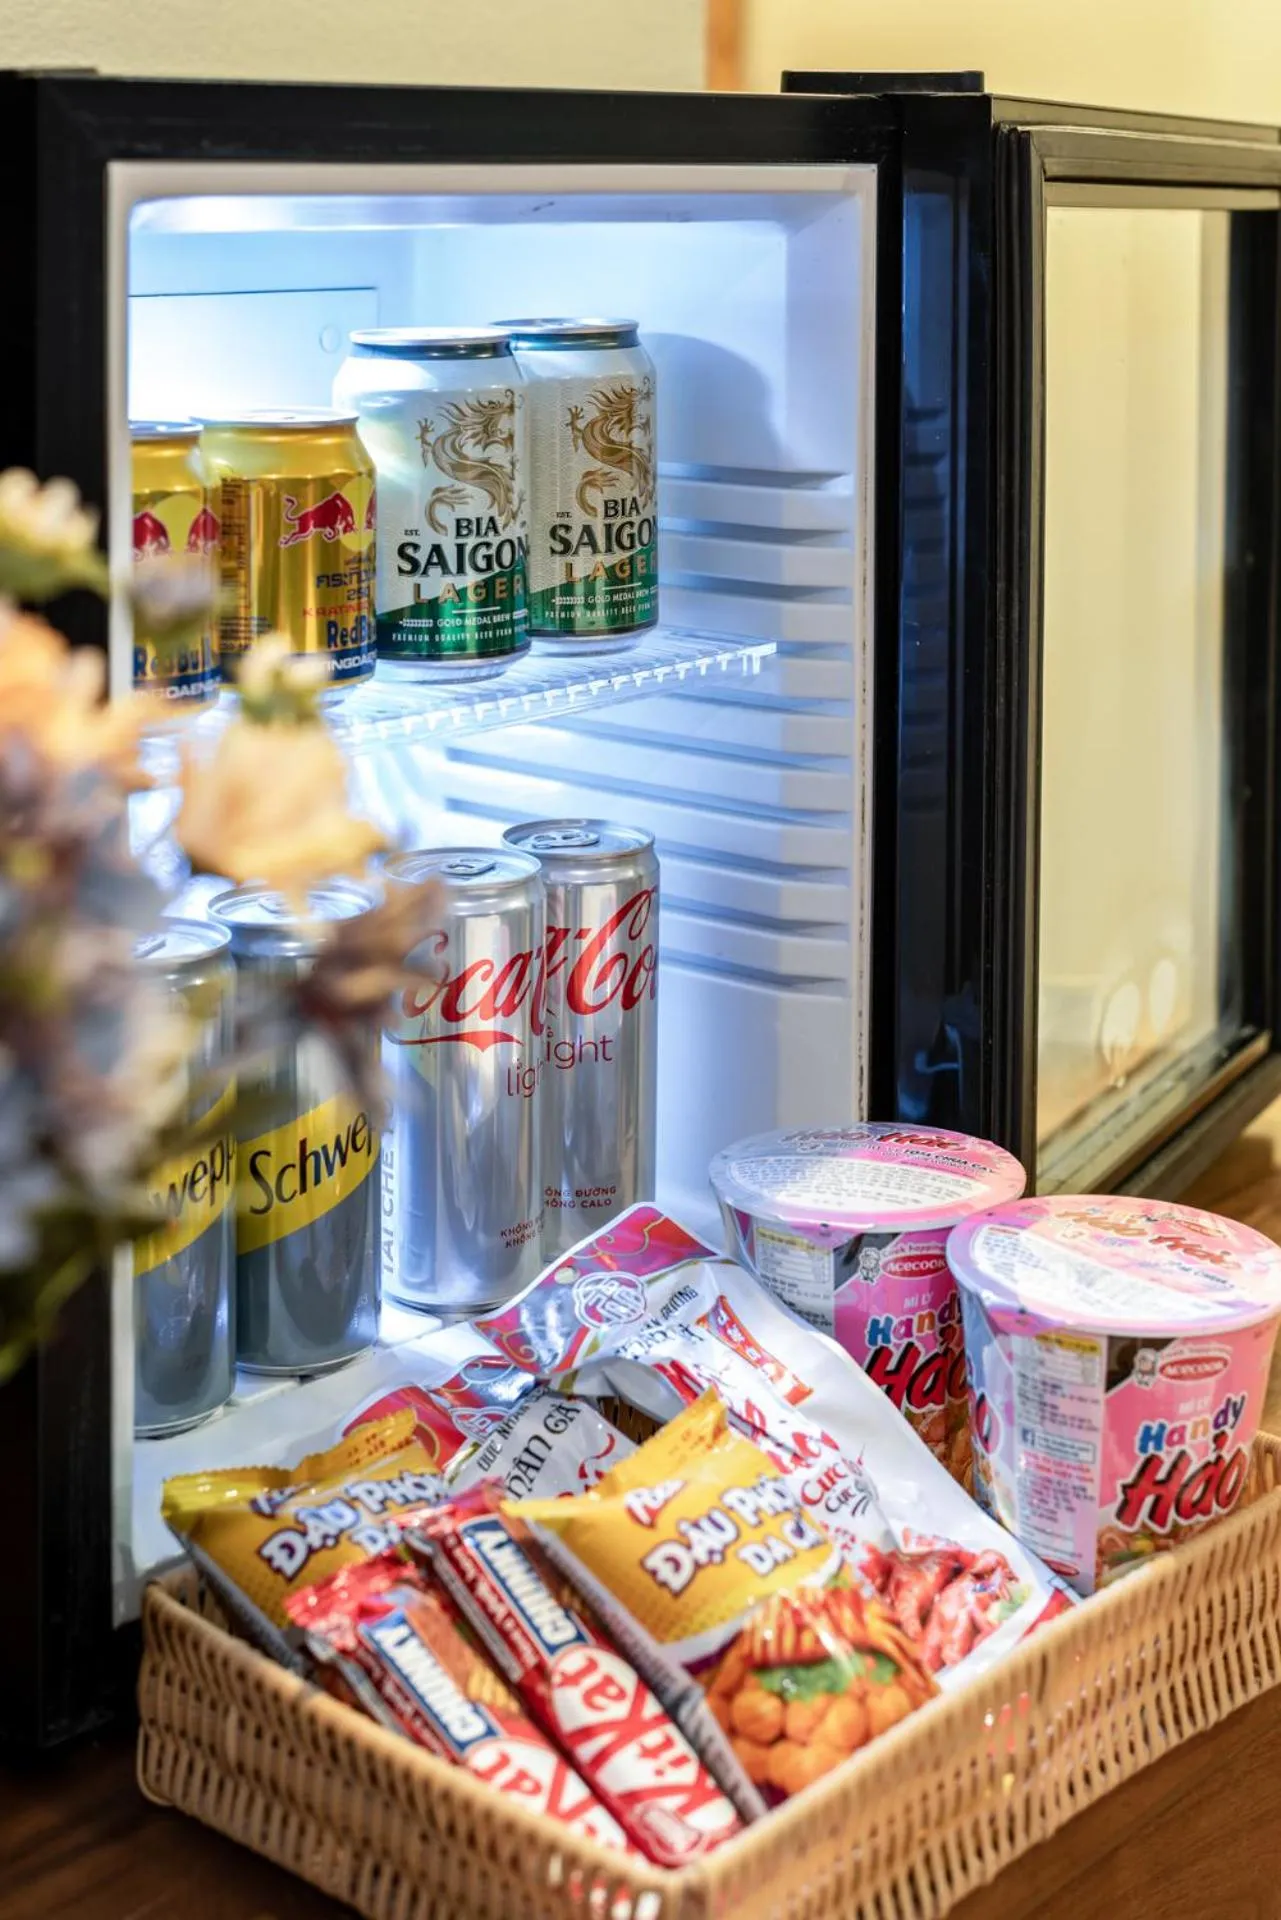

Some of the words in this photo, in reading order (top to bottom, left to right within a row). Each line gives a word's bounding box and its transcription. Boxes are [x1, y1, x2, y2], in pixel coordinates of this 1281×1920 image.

[556, 511, 572, 519] EST.
[603, 497, 641, 518] BIA
[403, 528, 420, 537] EST.
[455, 515, 500, 540] BIA
[397, 533, 529, 578] SAIGON
[588, 594, 611, 604] GOLD
[612, 591, 634, 602] MEDAL
[437, 617, 462, 628] GOLD
[464, 614, 491, 626] MEDAL
[493, 612, 511, 623] BREW
[545, 610, 582, 619] PREMIUM
[392, 632, 430, 643] PREMIUM
[434, 631, 471, 642] QUALITY
[546, 1035, 614, 1070] ight
[544, 1186, 571, 1197] ÔNG
[546, 1198, 576, 1208] ÔNG
[581, 1198, 612, 1208] CALO
[1138, 1394, 1246, 1455] Handy
[475, 1530, 576, 1645] CHUNKY
[370, 1622, 488, 1743] CHUNKY
